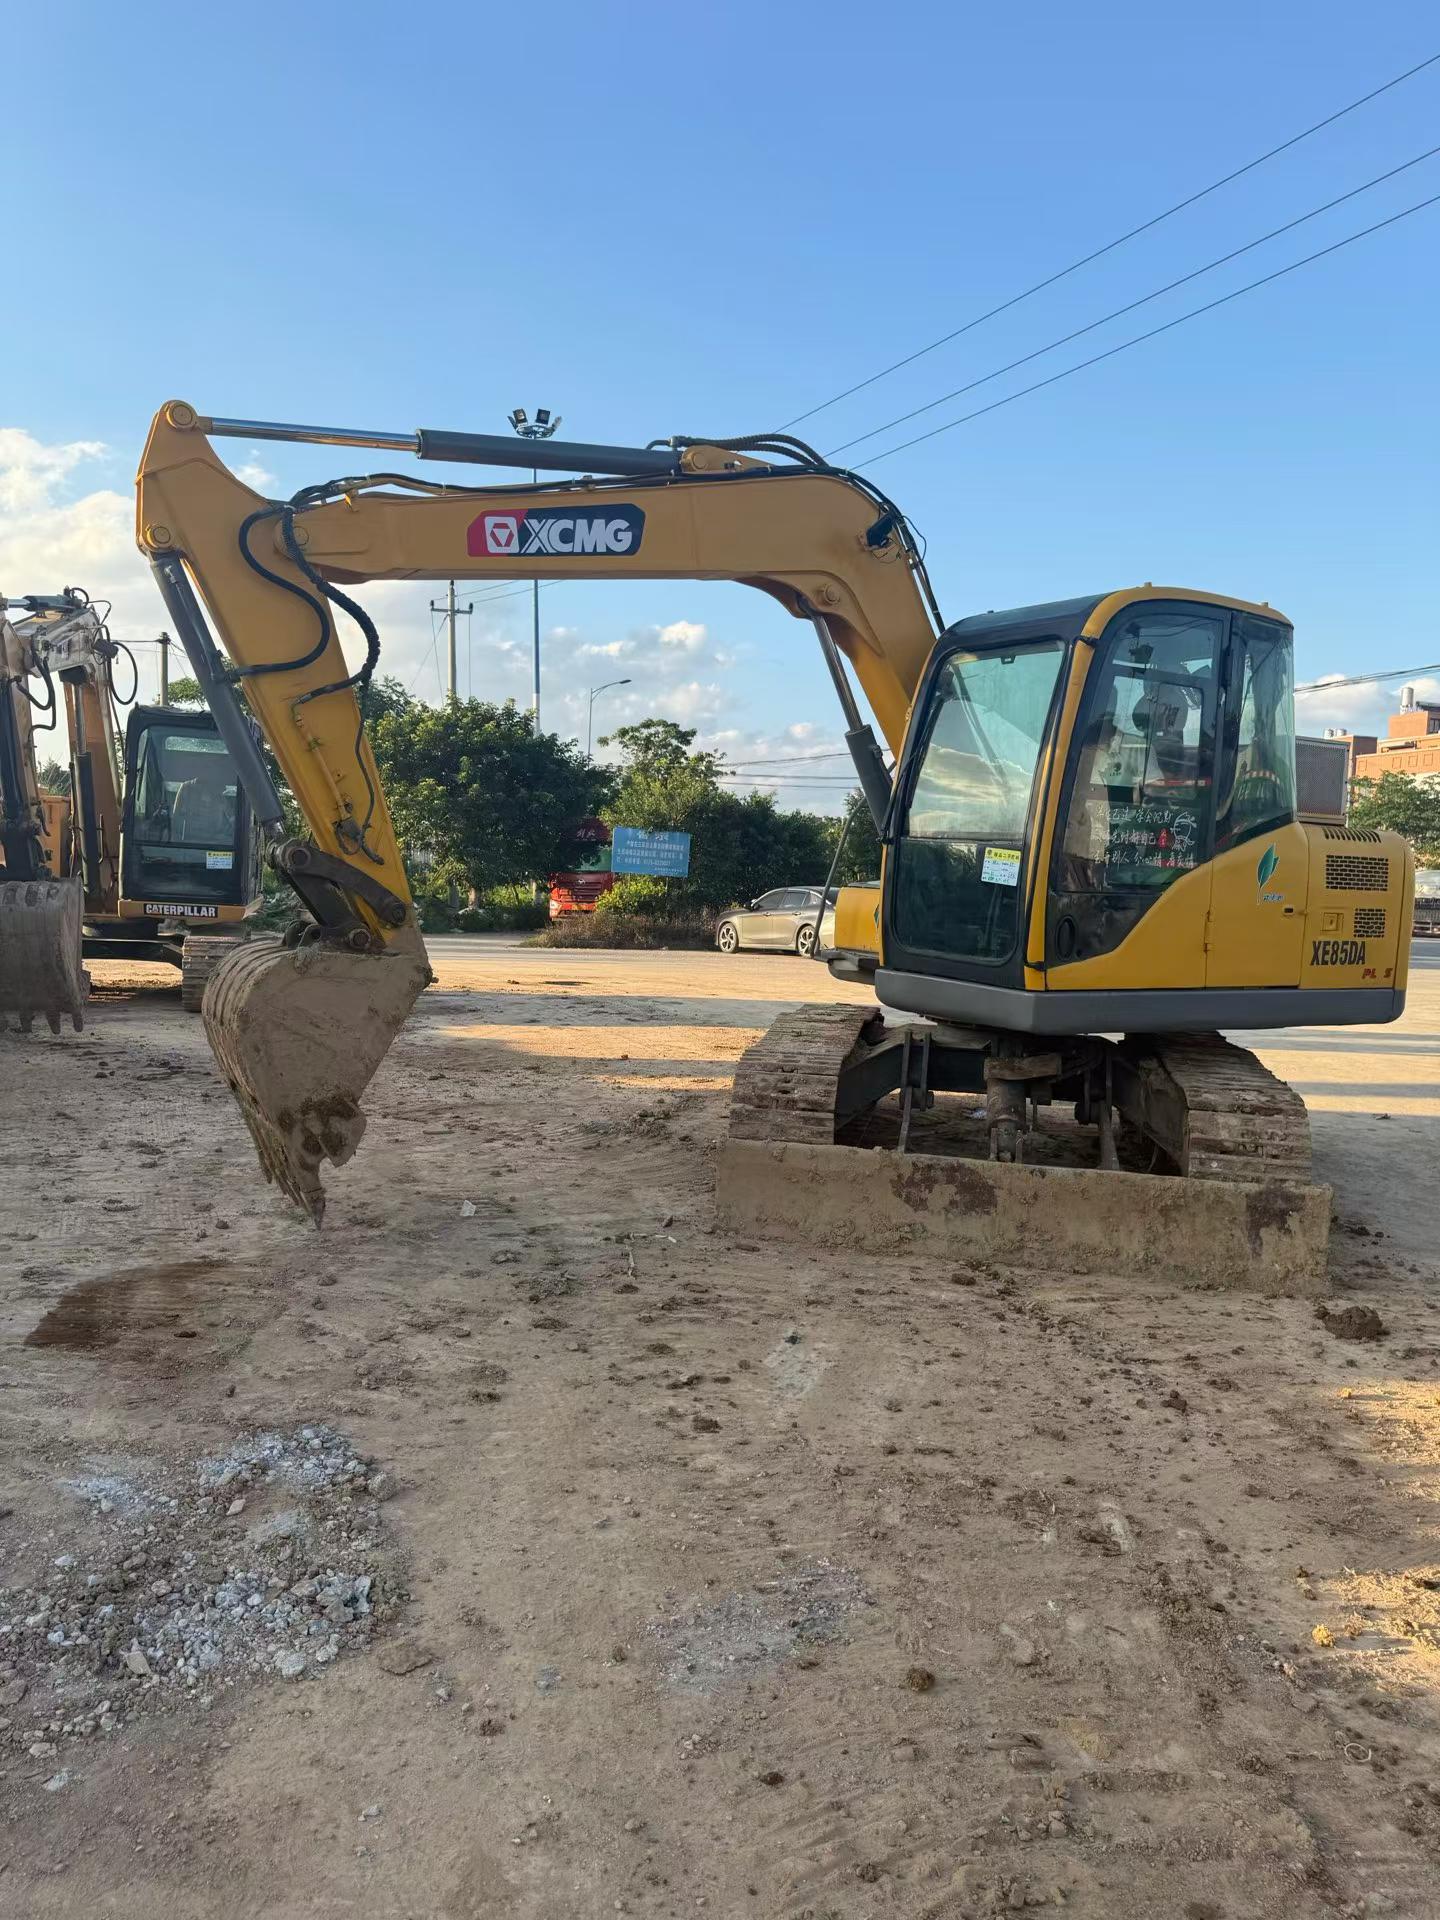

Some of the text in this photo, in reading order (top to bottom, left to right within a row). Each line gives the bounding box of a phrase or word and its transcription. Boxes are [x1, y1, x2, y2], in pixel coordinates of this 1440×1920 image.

[520, 518, 633, 553] XCMG
[146, 904, 216, 917] CATERPILLAR
[1310, 940, 1366, 966] XE85DA
[1362, 967, 1393, 980] PLS
